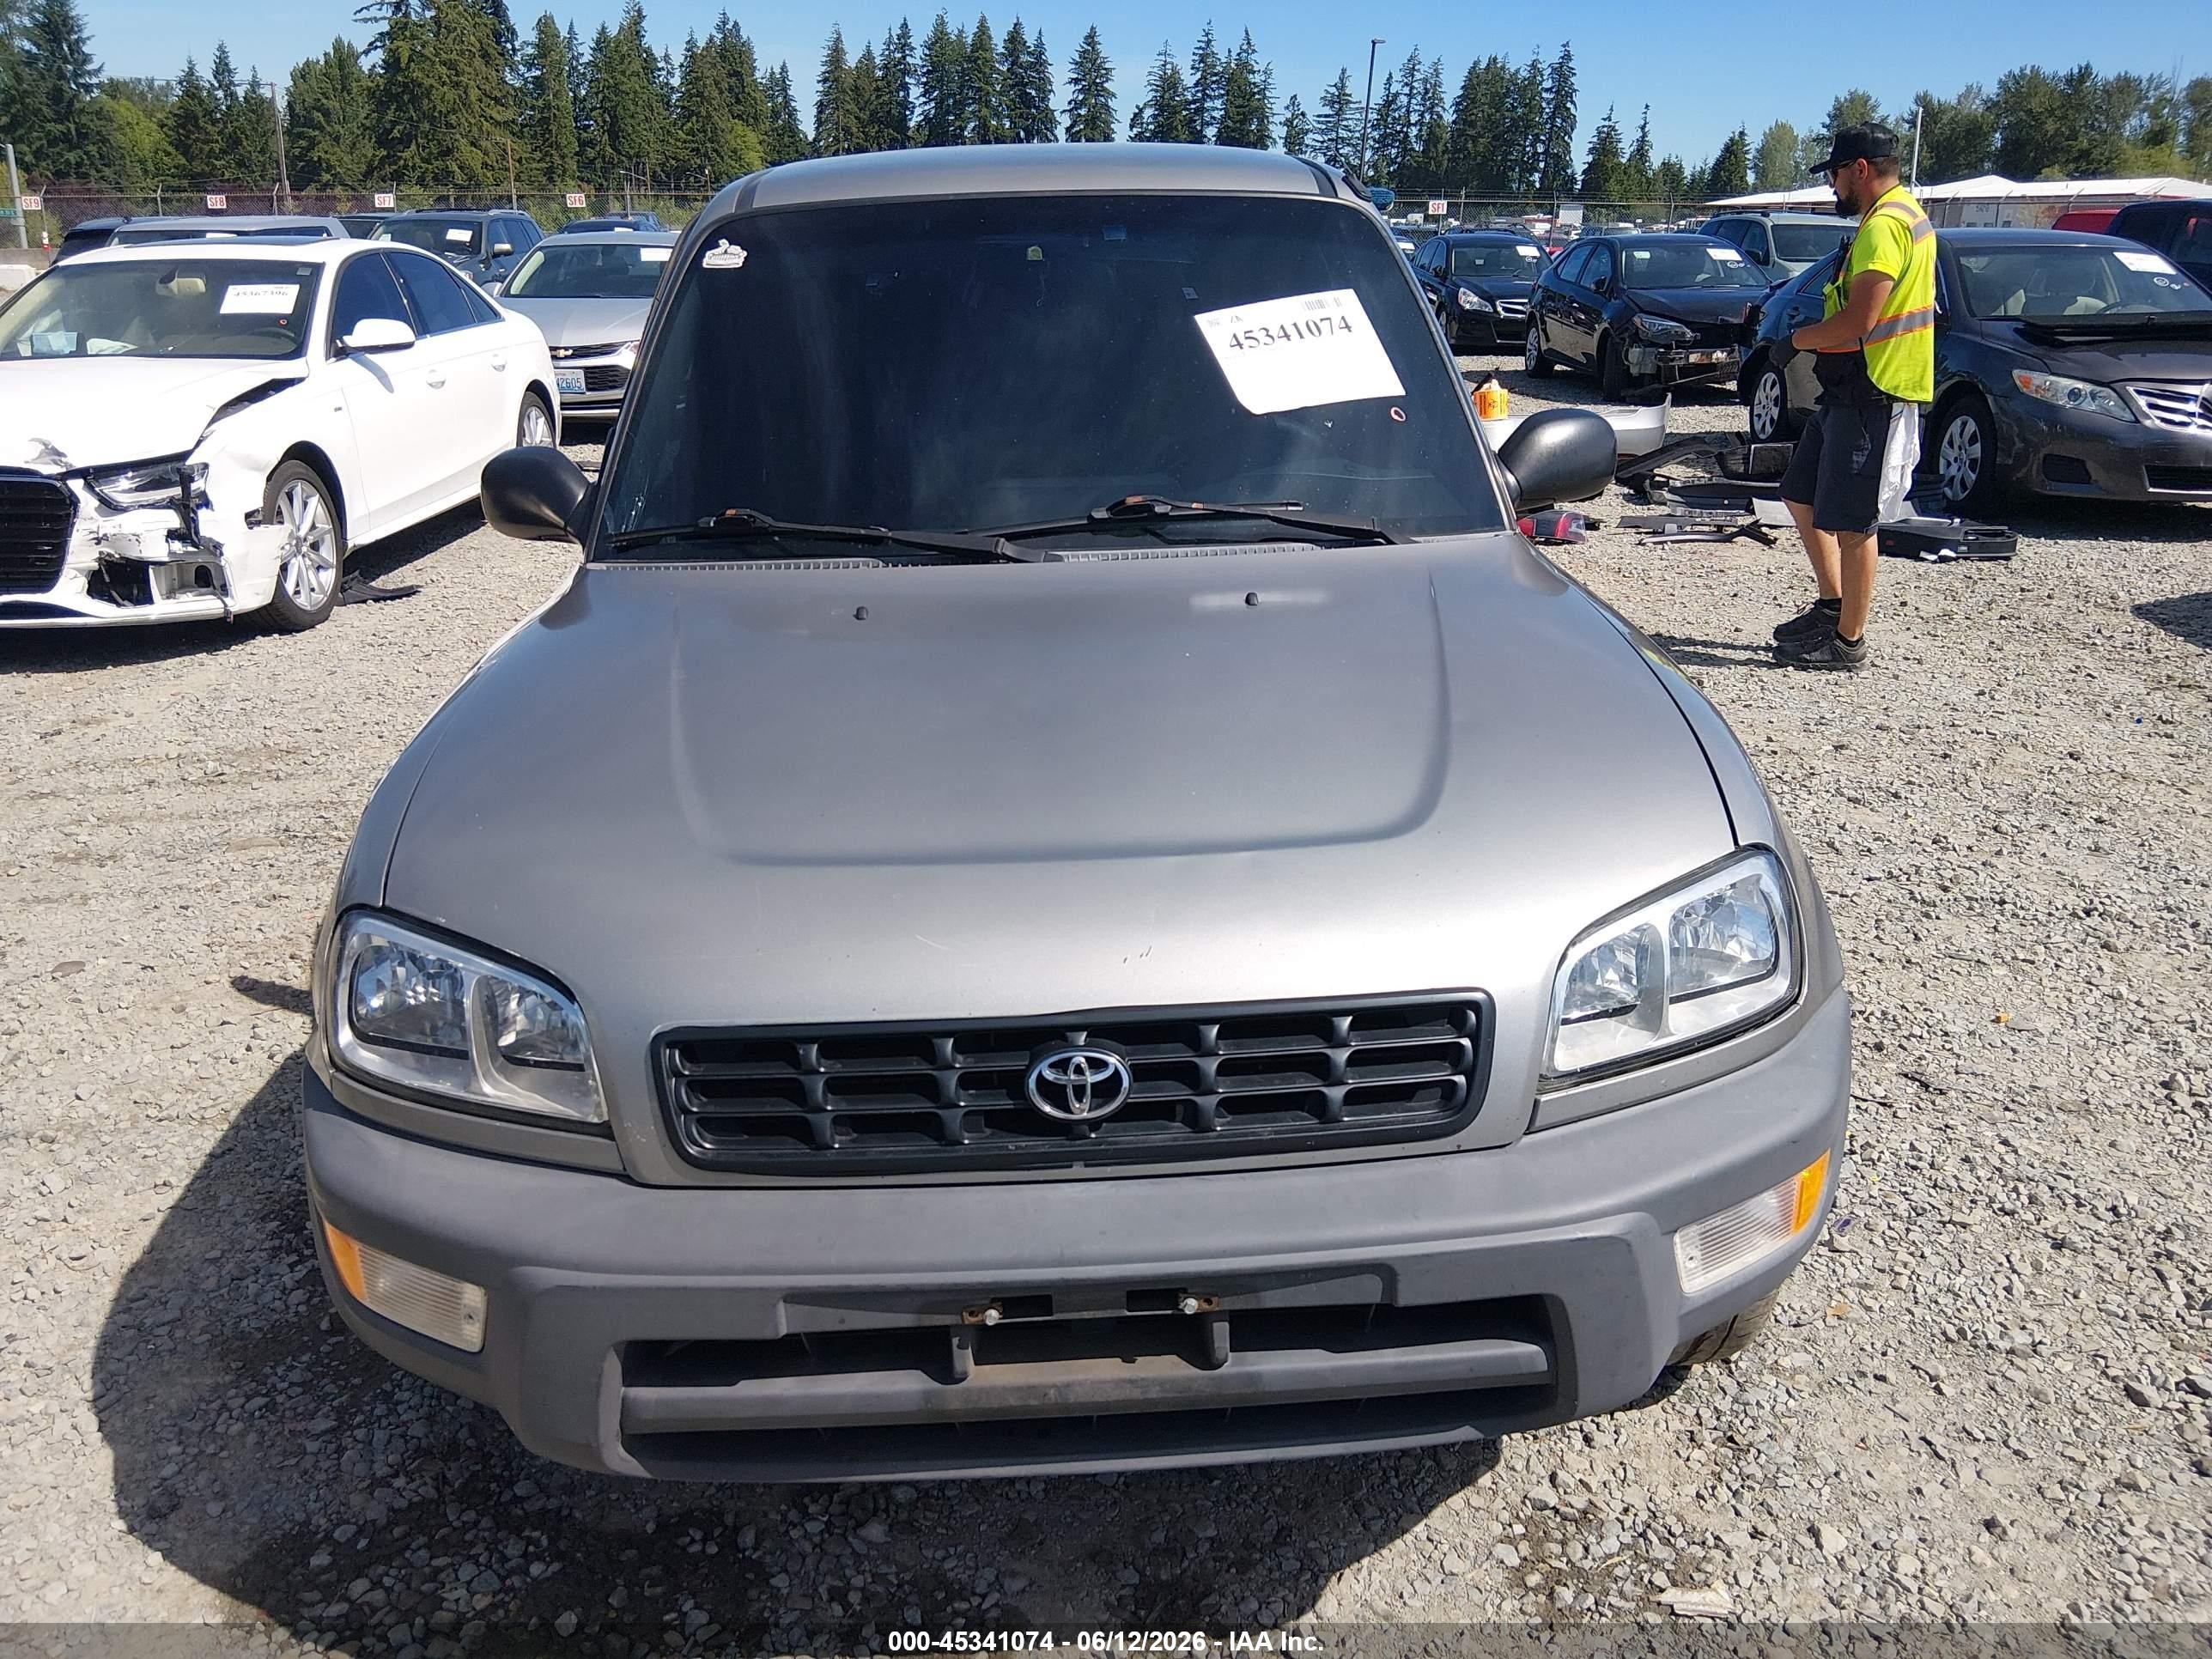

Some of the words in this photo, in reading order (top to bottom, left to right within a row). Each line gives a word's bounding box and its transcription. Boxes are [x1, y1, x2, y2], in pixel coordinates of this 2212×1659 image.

[23, 198, 40, 208] SF9
[209, 197, 225, 207] SF8
[377, 196, 392, 206] SF7
[568, 195, 584, 206] SF6
[1431, 202, 1444, 213] SF1
[1229, 315, 1352, 351] 45341074
